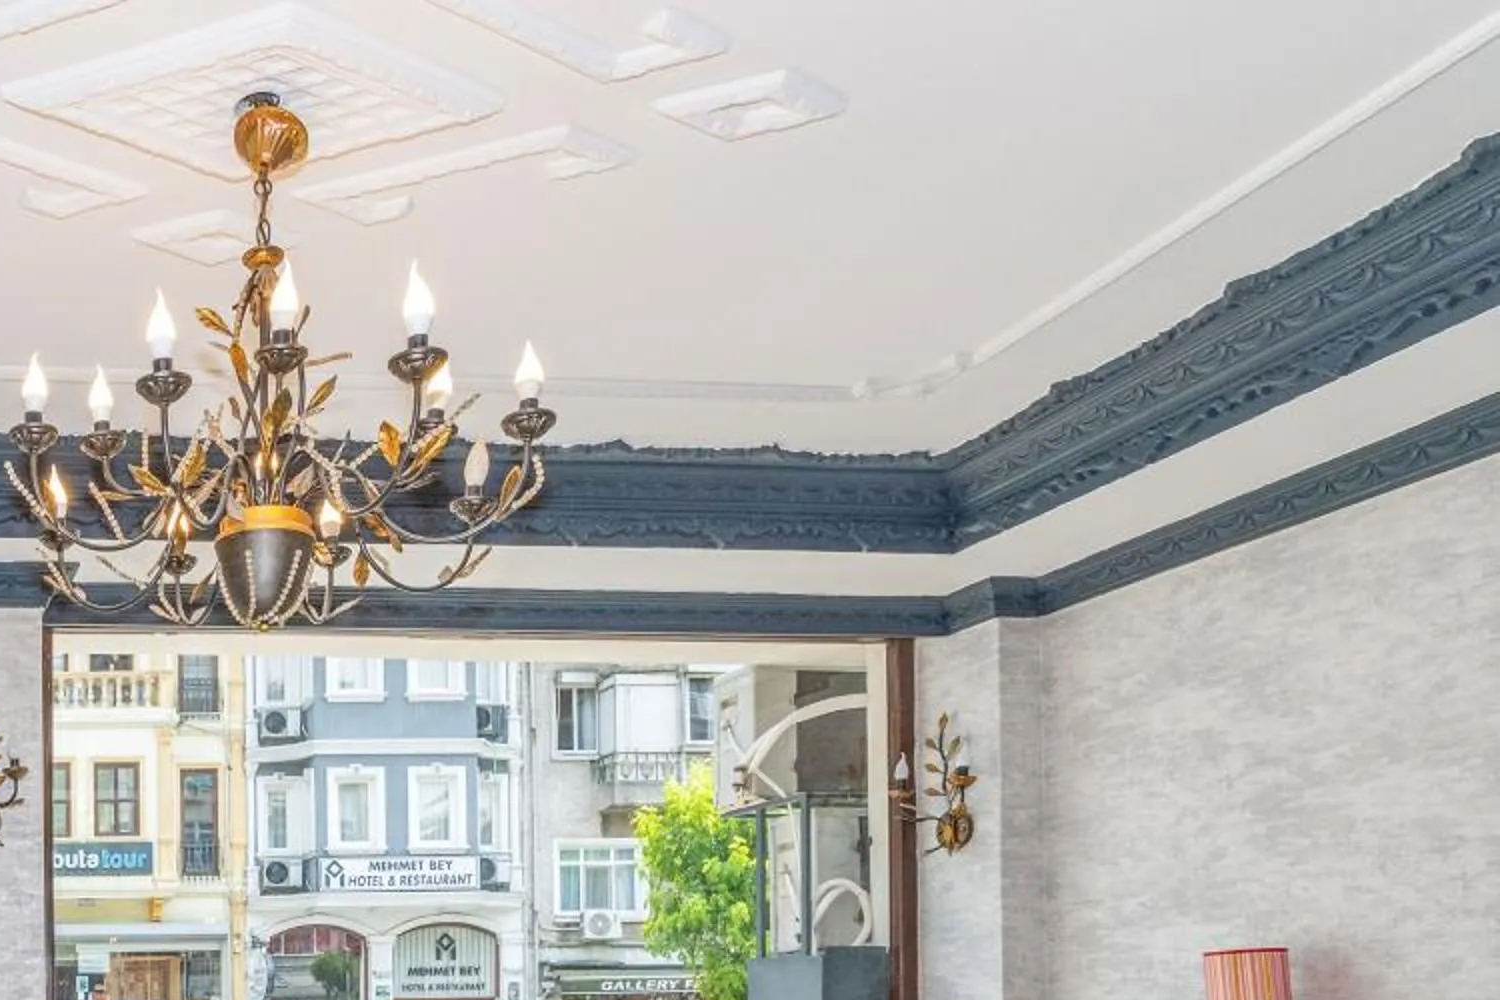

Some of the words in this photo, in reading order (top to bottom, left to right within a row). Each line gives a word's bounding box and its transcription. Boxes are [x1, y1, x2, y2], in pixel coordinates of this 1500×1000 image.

[368, 859, 423, 872] MEHMET
[429, 859, 453, 871] BEY
[349, 875, 384, 887] HOTEL
[387, 874, 396, 887] &
[399, 873, 473, 887] RESTAURANT
[601, 979, 680, 992] GALLERY
